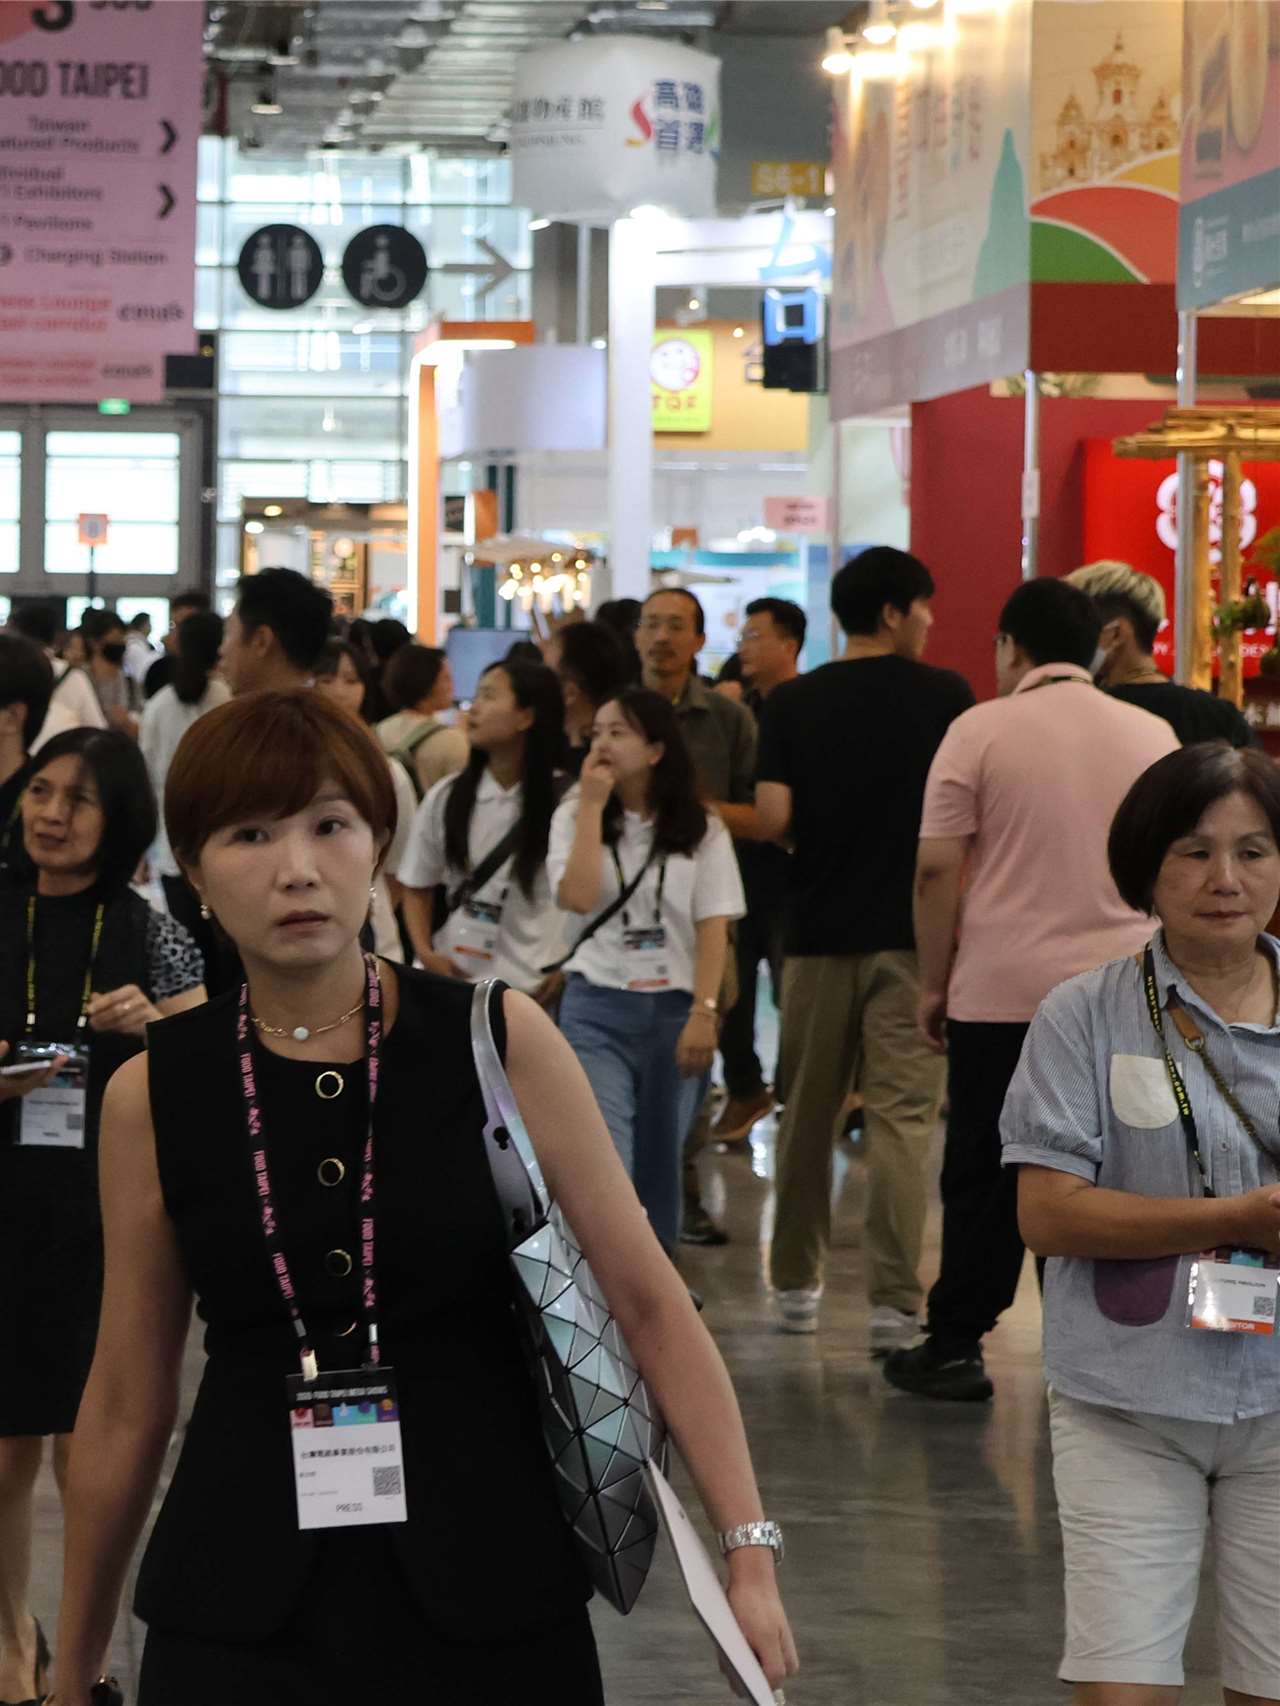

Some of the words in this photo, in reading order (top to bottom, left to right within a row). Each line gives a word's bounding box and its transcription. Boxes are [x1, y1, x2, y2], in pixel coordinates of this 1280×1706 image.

[60, 62, 150, 100] TAIPEI
[256, 1171, 271, 1197] TAIPEI
[278, 1273, 296, 1300] TAIPEI
